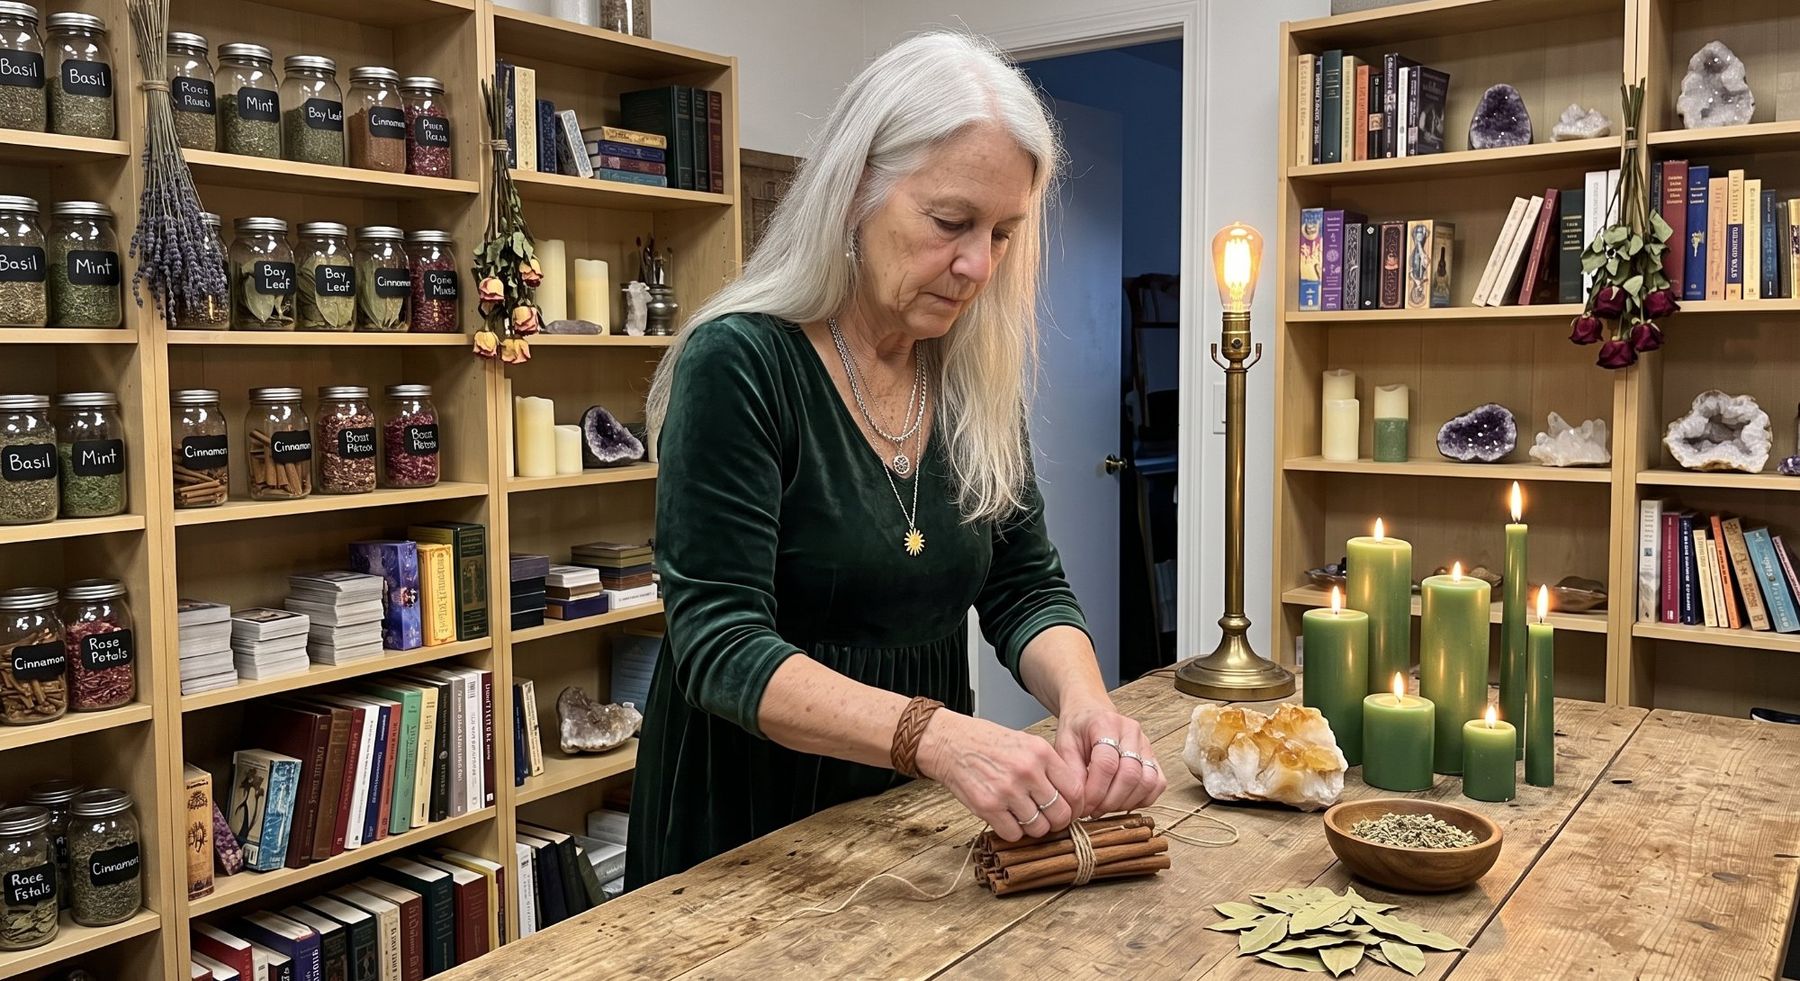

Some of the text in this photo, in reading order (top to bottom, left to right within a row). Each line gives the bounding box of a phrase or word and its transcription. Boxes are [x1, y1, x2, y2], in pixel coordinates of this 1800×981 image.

[1, 57, 38, 78] Basil
[69, 68, 106, 87] Basil
[246, 96, 274, 113] Mint
[308, 106, 342, 122] Bay Leaf
[0, 254, 38, 272] Basil
[75, 258, 113, 276] Mint
[263, 264, 286, 280] Bay
[325, 267, 346, 281] Bay
[265, 278, 291, 290] Leaf
[326, 280, 351, 293] Leaf
[274, 440, 312, 453] Cinnamon
[9, 452, 51, 471] Basil
[81, 448, 117, 467] Mint
[88, 637, 120, 651] Rose
[14, 655, 65, 671] Cinnamon
[92, 855, 140, 876] Cinnamon
